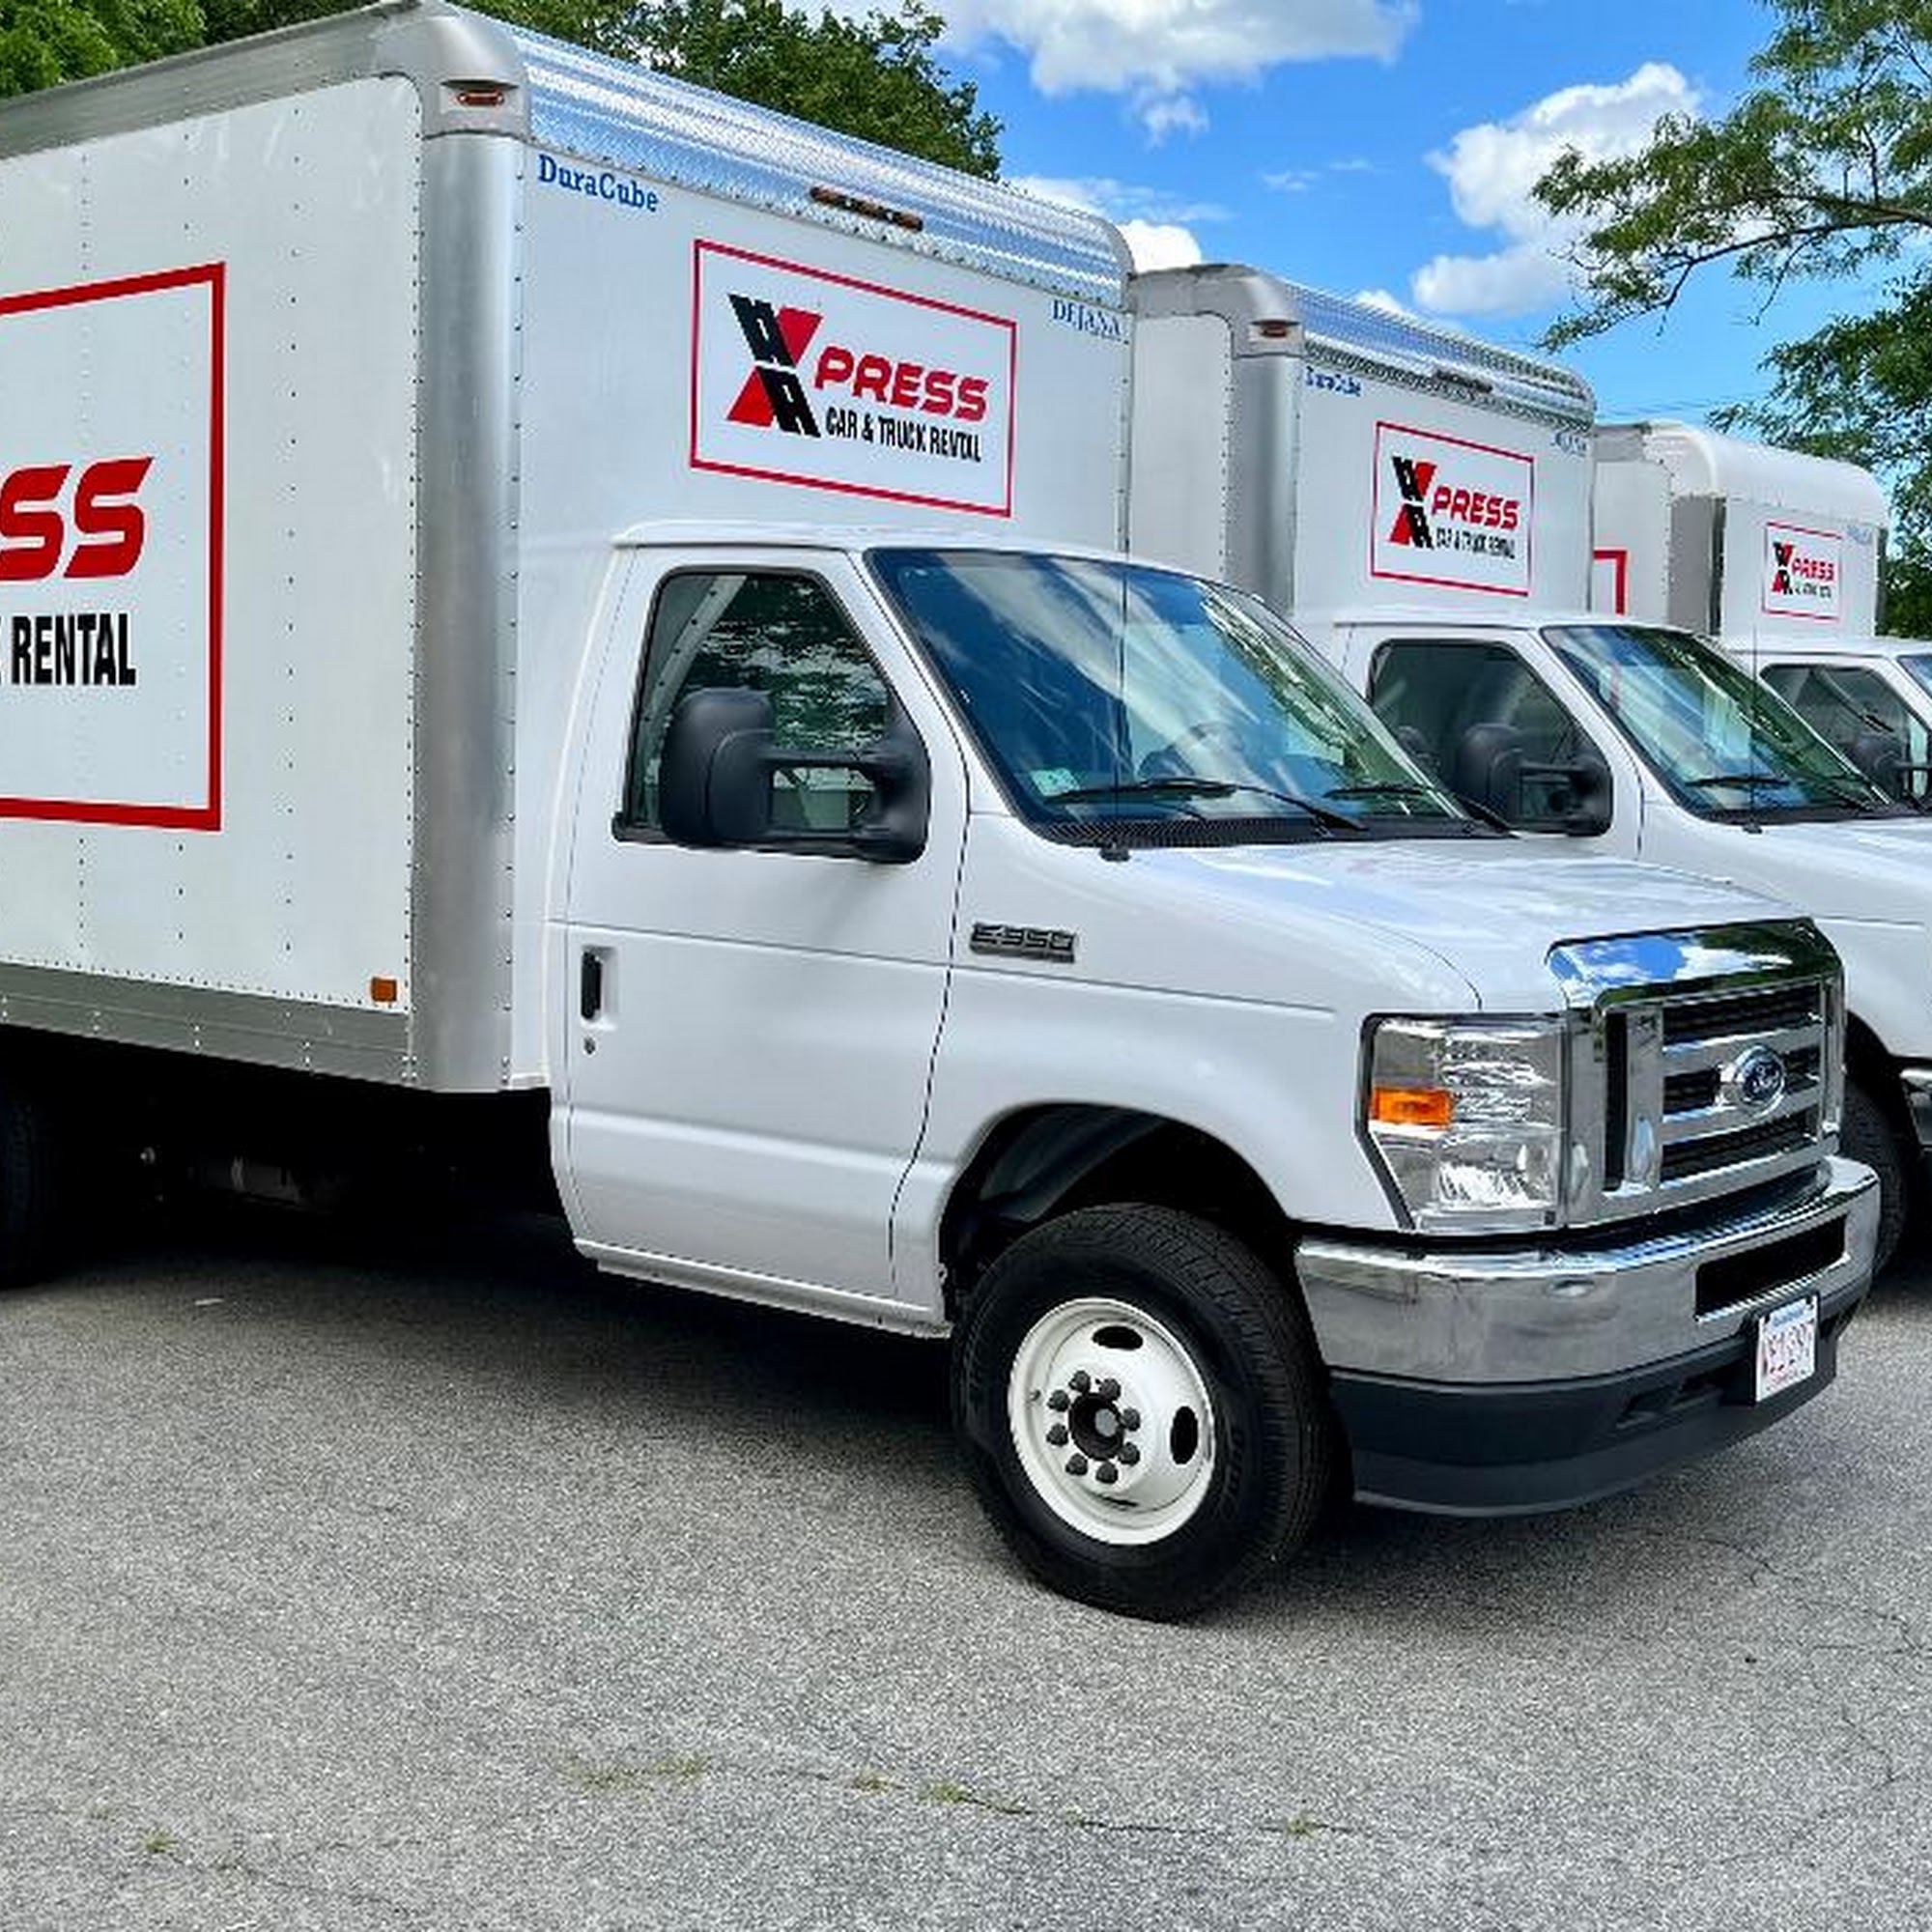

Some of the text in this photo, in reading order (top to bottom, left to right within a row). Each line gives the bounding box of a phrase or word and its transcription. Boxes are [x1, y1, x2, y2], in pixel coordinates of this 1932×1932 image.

[538, 154, 659, 212] DuraCube
[826, 407, 857, 440] CAR
[862, 414, 873, 442] &
[877, 416, 926, 452] TRUCK
[12, 613, 136, 686] RENTAL
